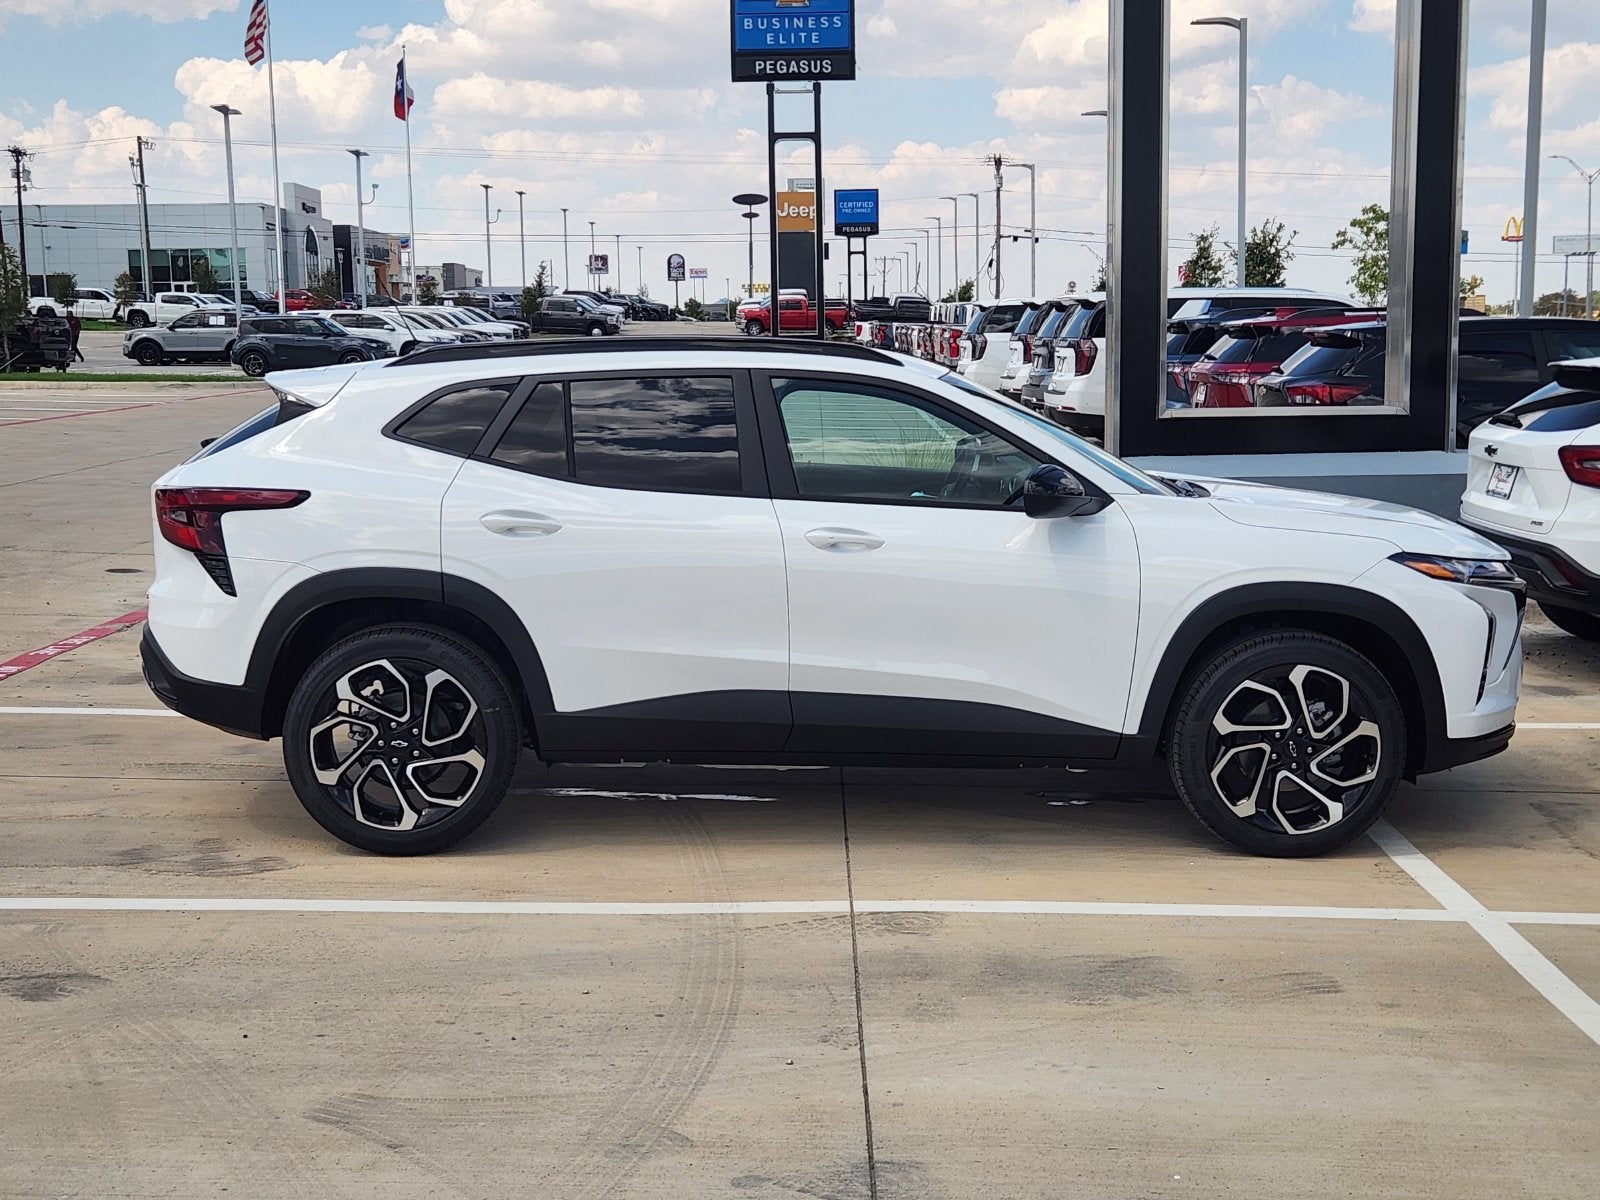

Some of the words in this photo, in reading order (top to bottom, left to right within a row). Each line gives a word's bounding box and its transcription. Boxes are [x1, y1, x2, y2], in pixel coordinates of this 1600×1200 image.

[743, 16, 842, 30] BUSINESS
[766, 32, 820, 45] ELITE
[755, 60, 832, 74] PEGASUS
[839, 201, 874, 209] CERTIFIED
